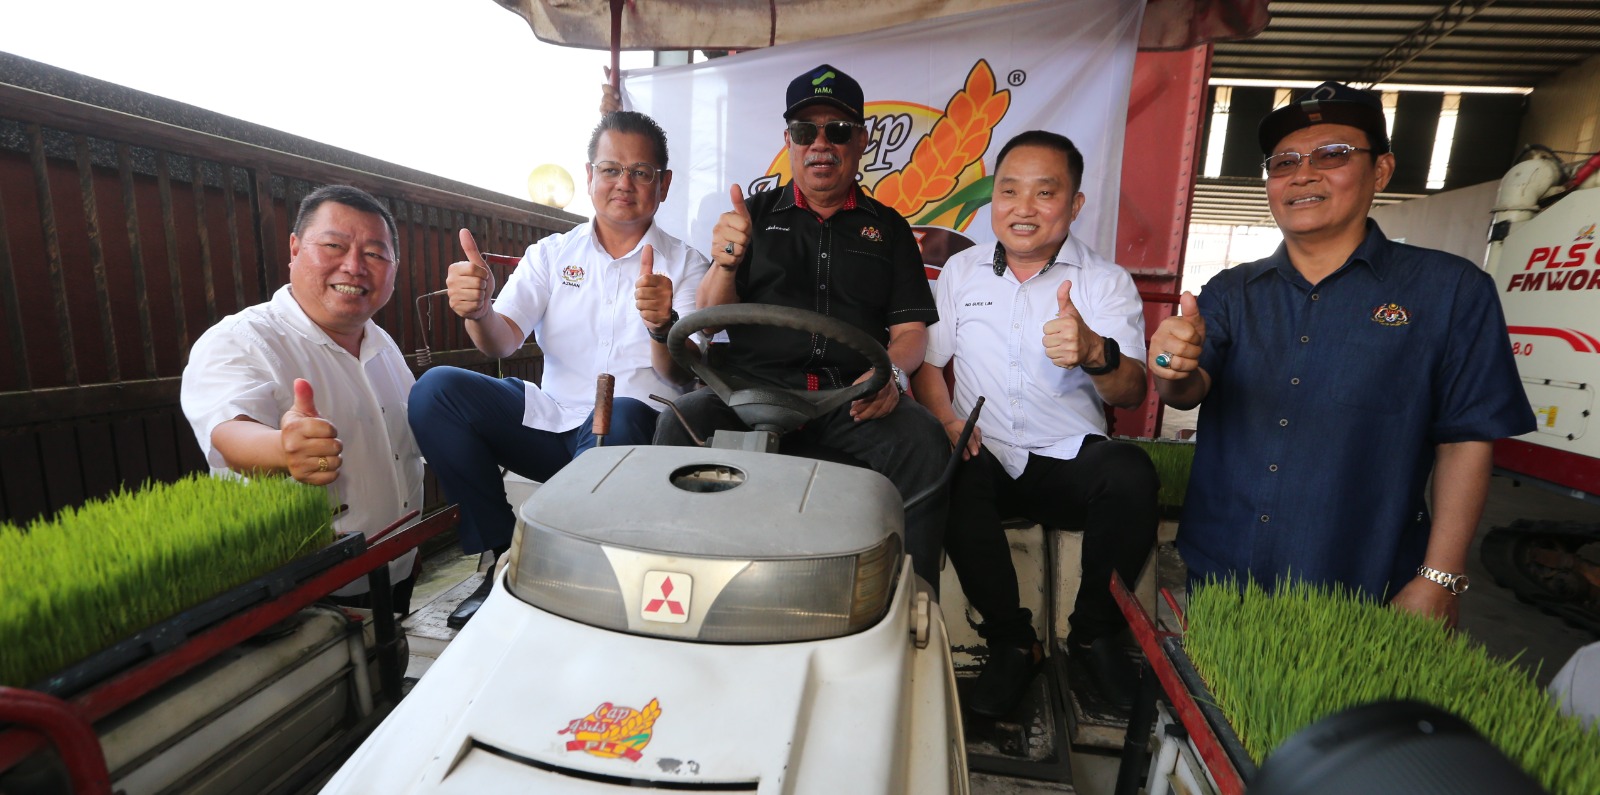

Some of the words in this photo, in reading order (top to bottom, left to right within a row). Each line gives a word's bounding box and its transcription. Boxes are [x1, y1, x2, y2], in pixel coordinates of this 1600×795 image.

[814, 86, 833, 94] FAMA
[1524, 242, 1594, 270] PLS
[594, 703, 630, 724] Cap
